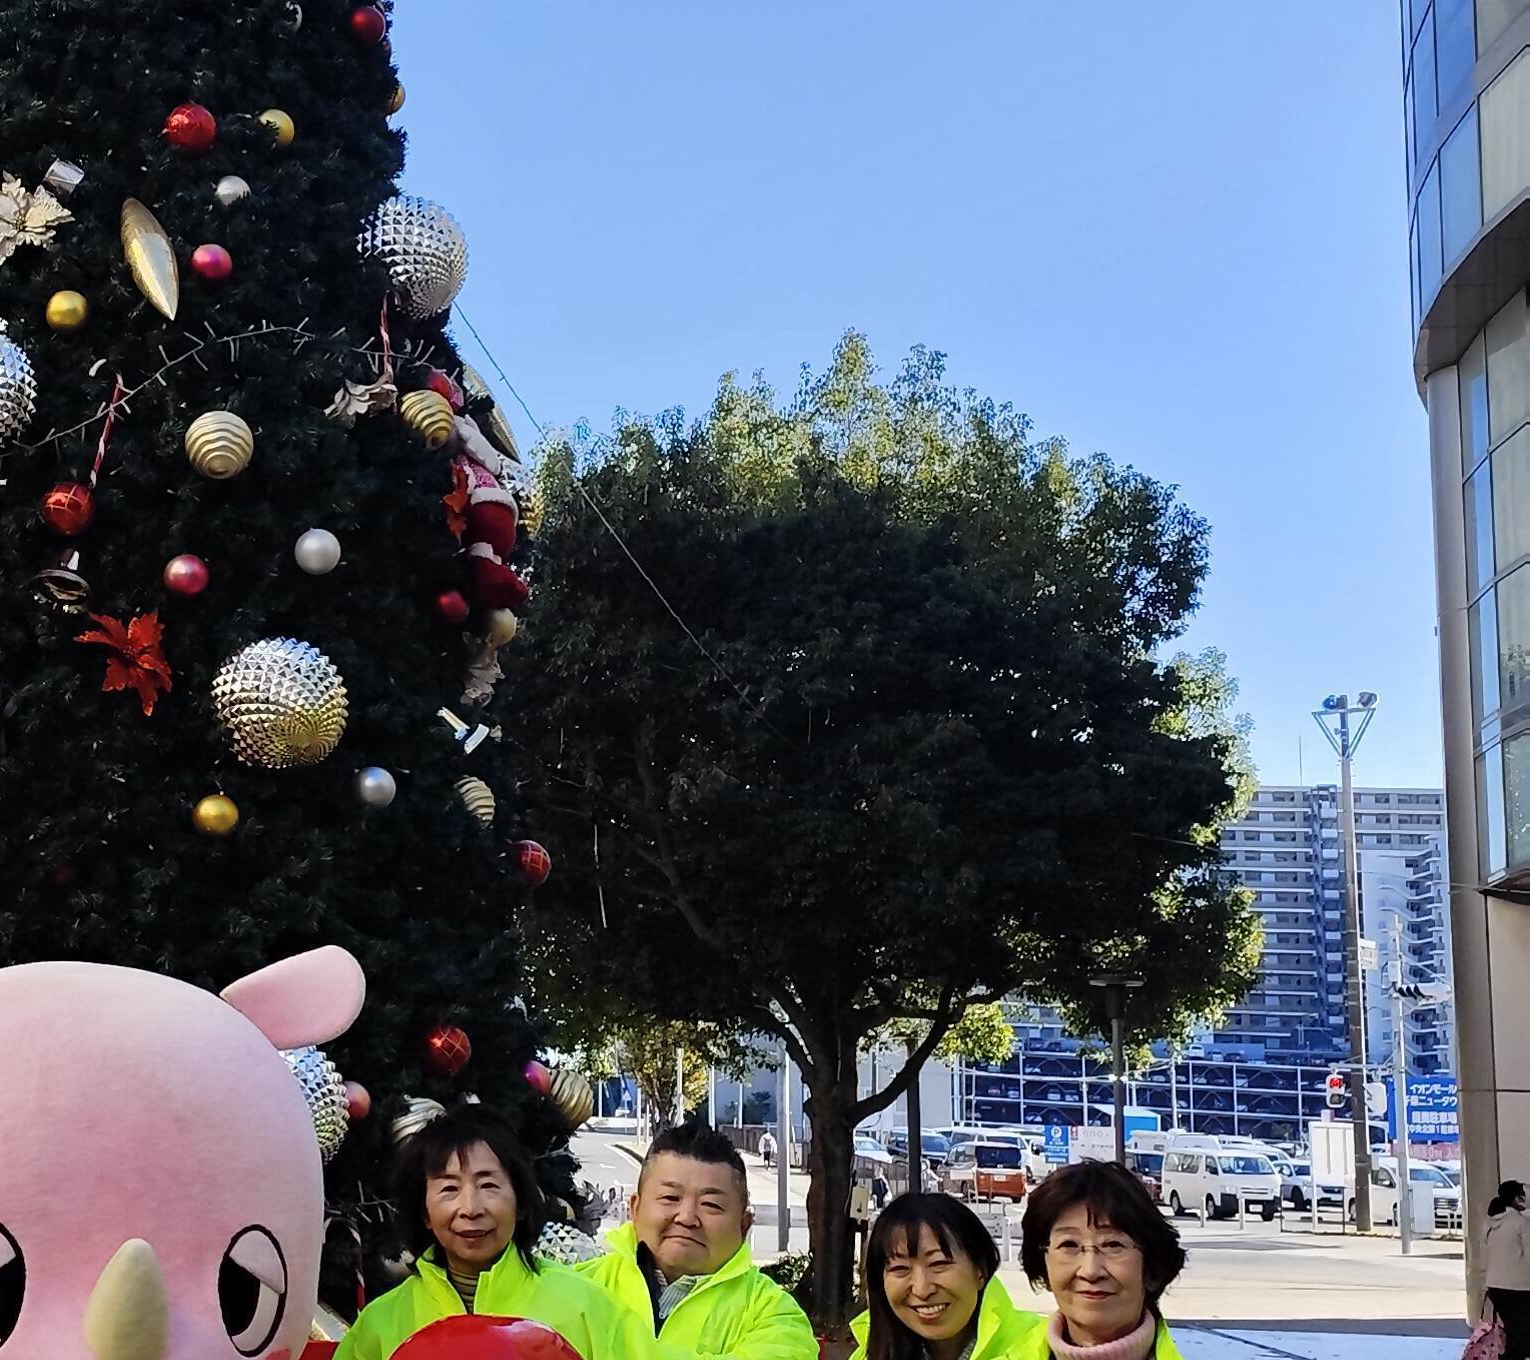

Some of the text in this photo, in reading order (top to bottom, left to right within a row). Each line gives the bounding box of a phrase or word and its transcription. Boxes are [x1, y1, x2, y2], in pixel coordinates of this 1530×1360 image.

[1410, 1083, 1458, 1095] イオンモール
